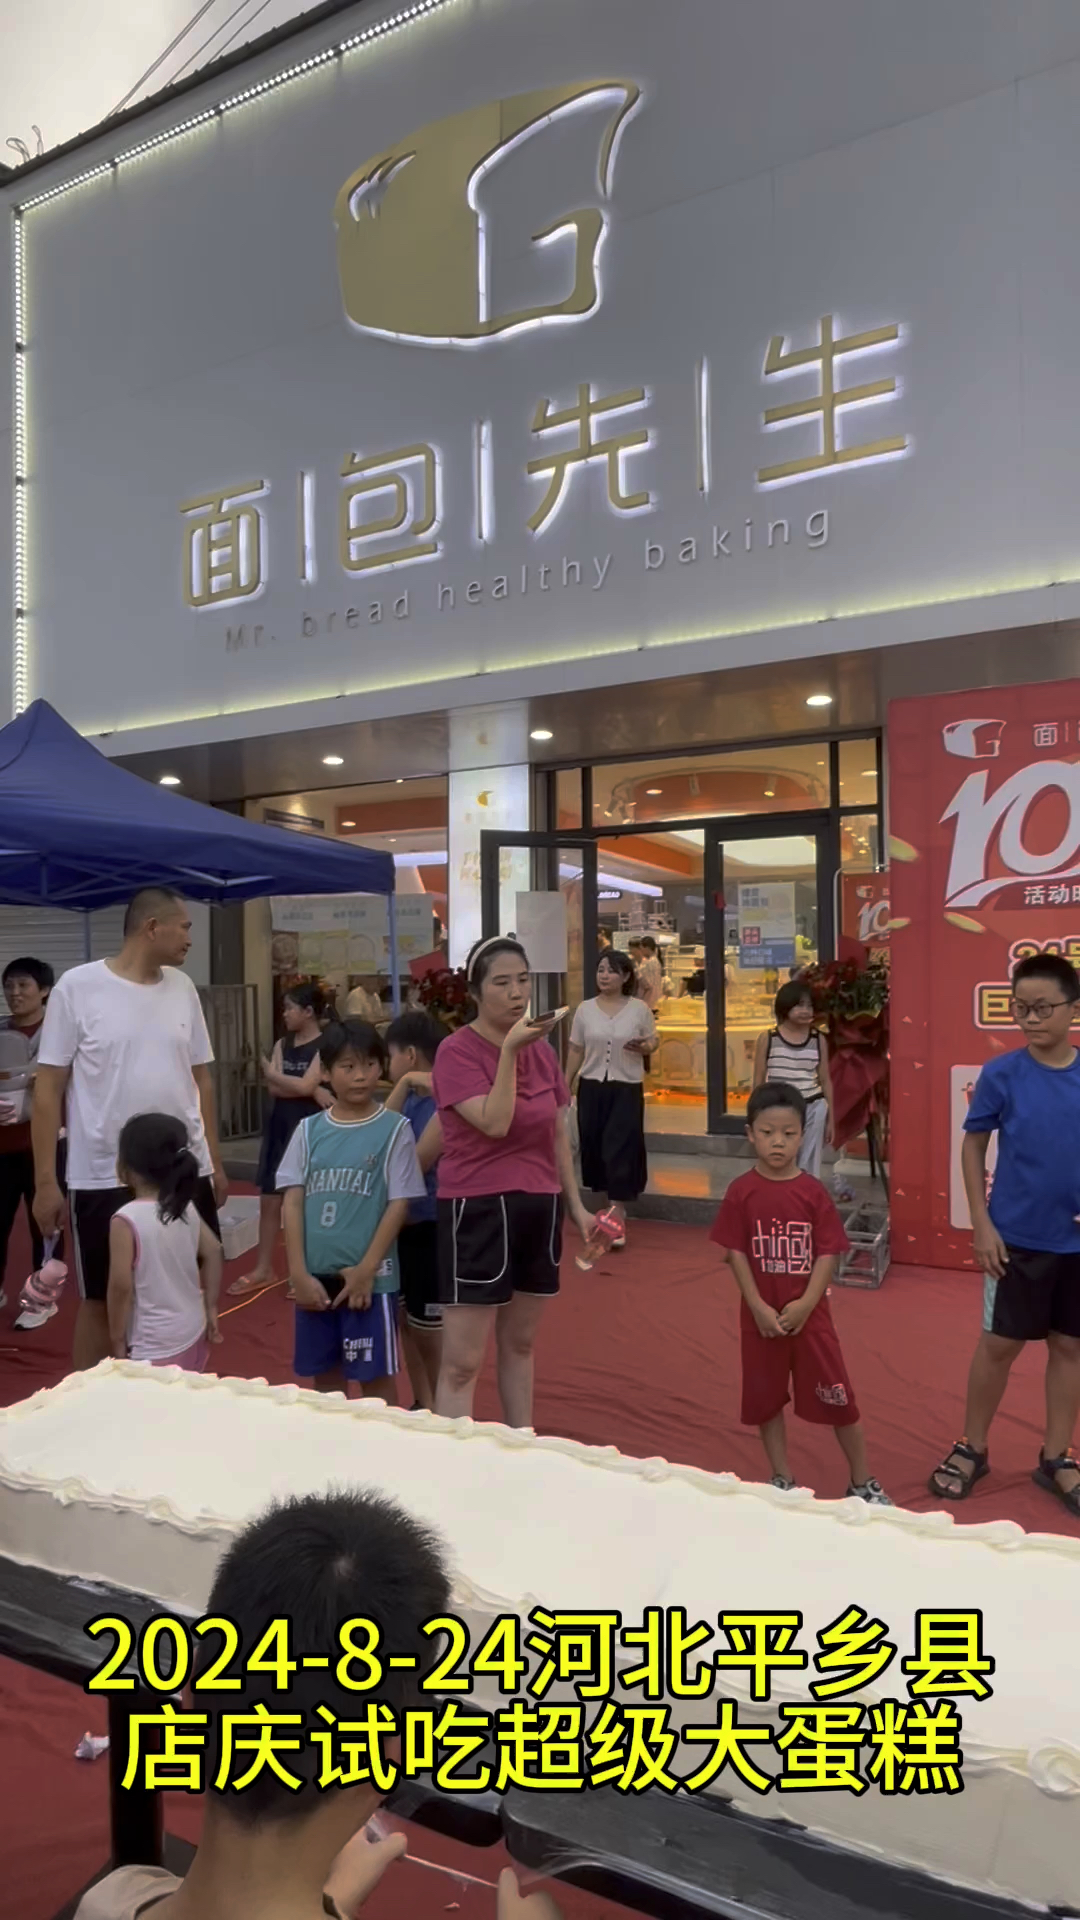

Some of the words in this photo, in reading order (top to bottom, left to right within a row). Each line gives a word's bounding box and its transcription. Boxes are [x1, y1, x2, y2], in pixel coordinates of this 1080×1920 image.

[302, 588, 411, 639] bread
[436, 550, 614, 612] healthy
[643, 508, 832, 571] baking
[320, 1200, 337, 1228] 8
